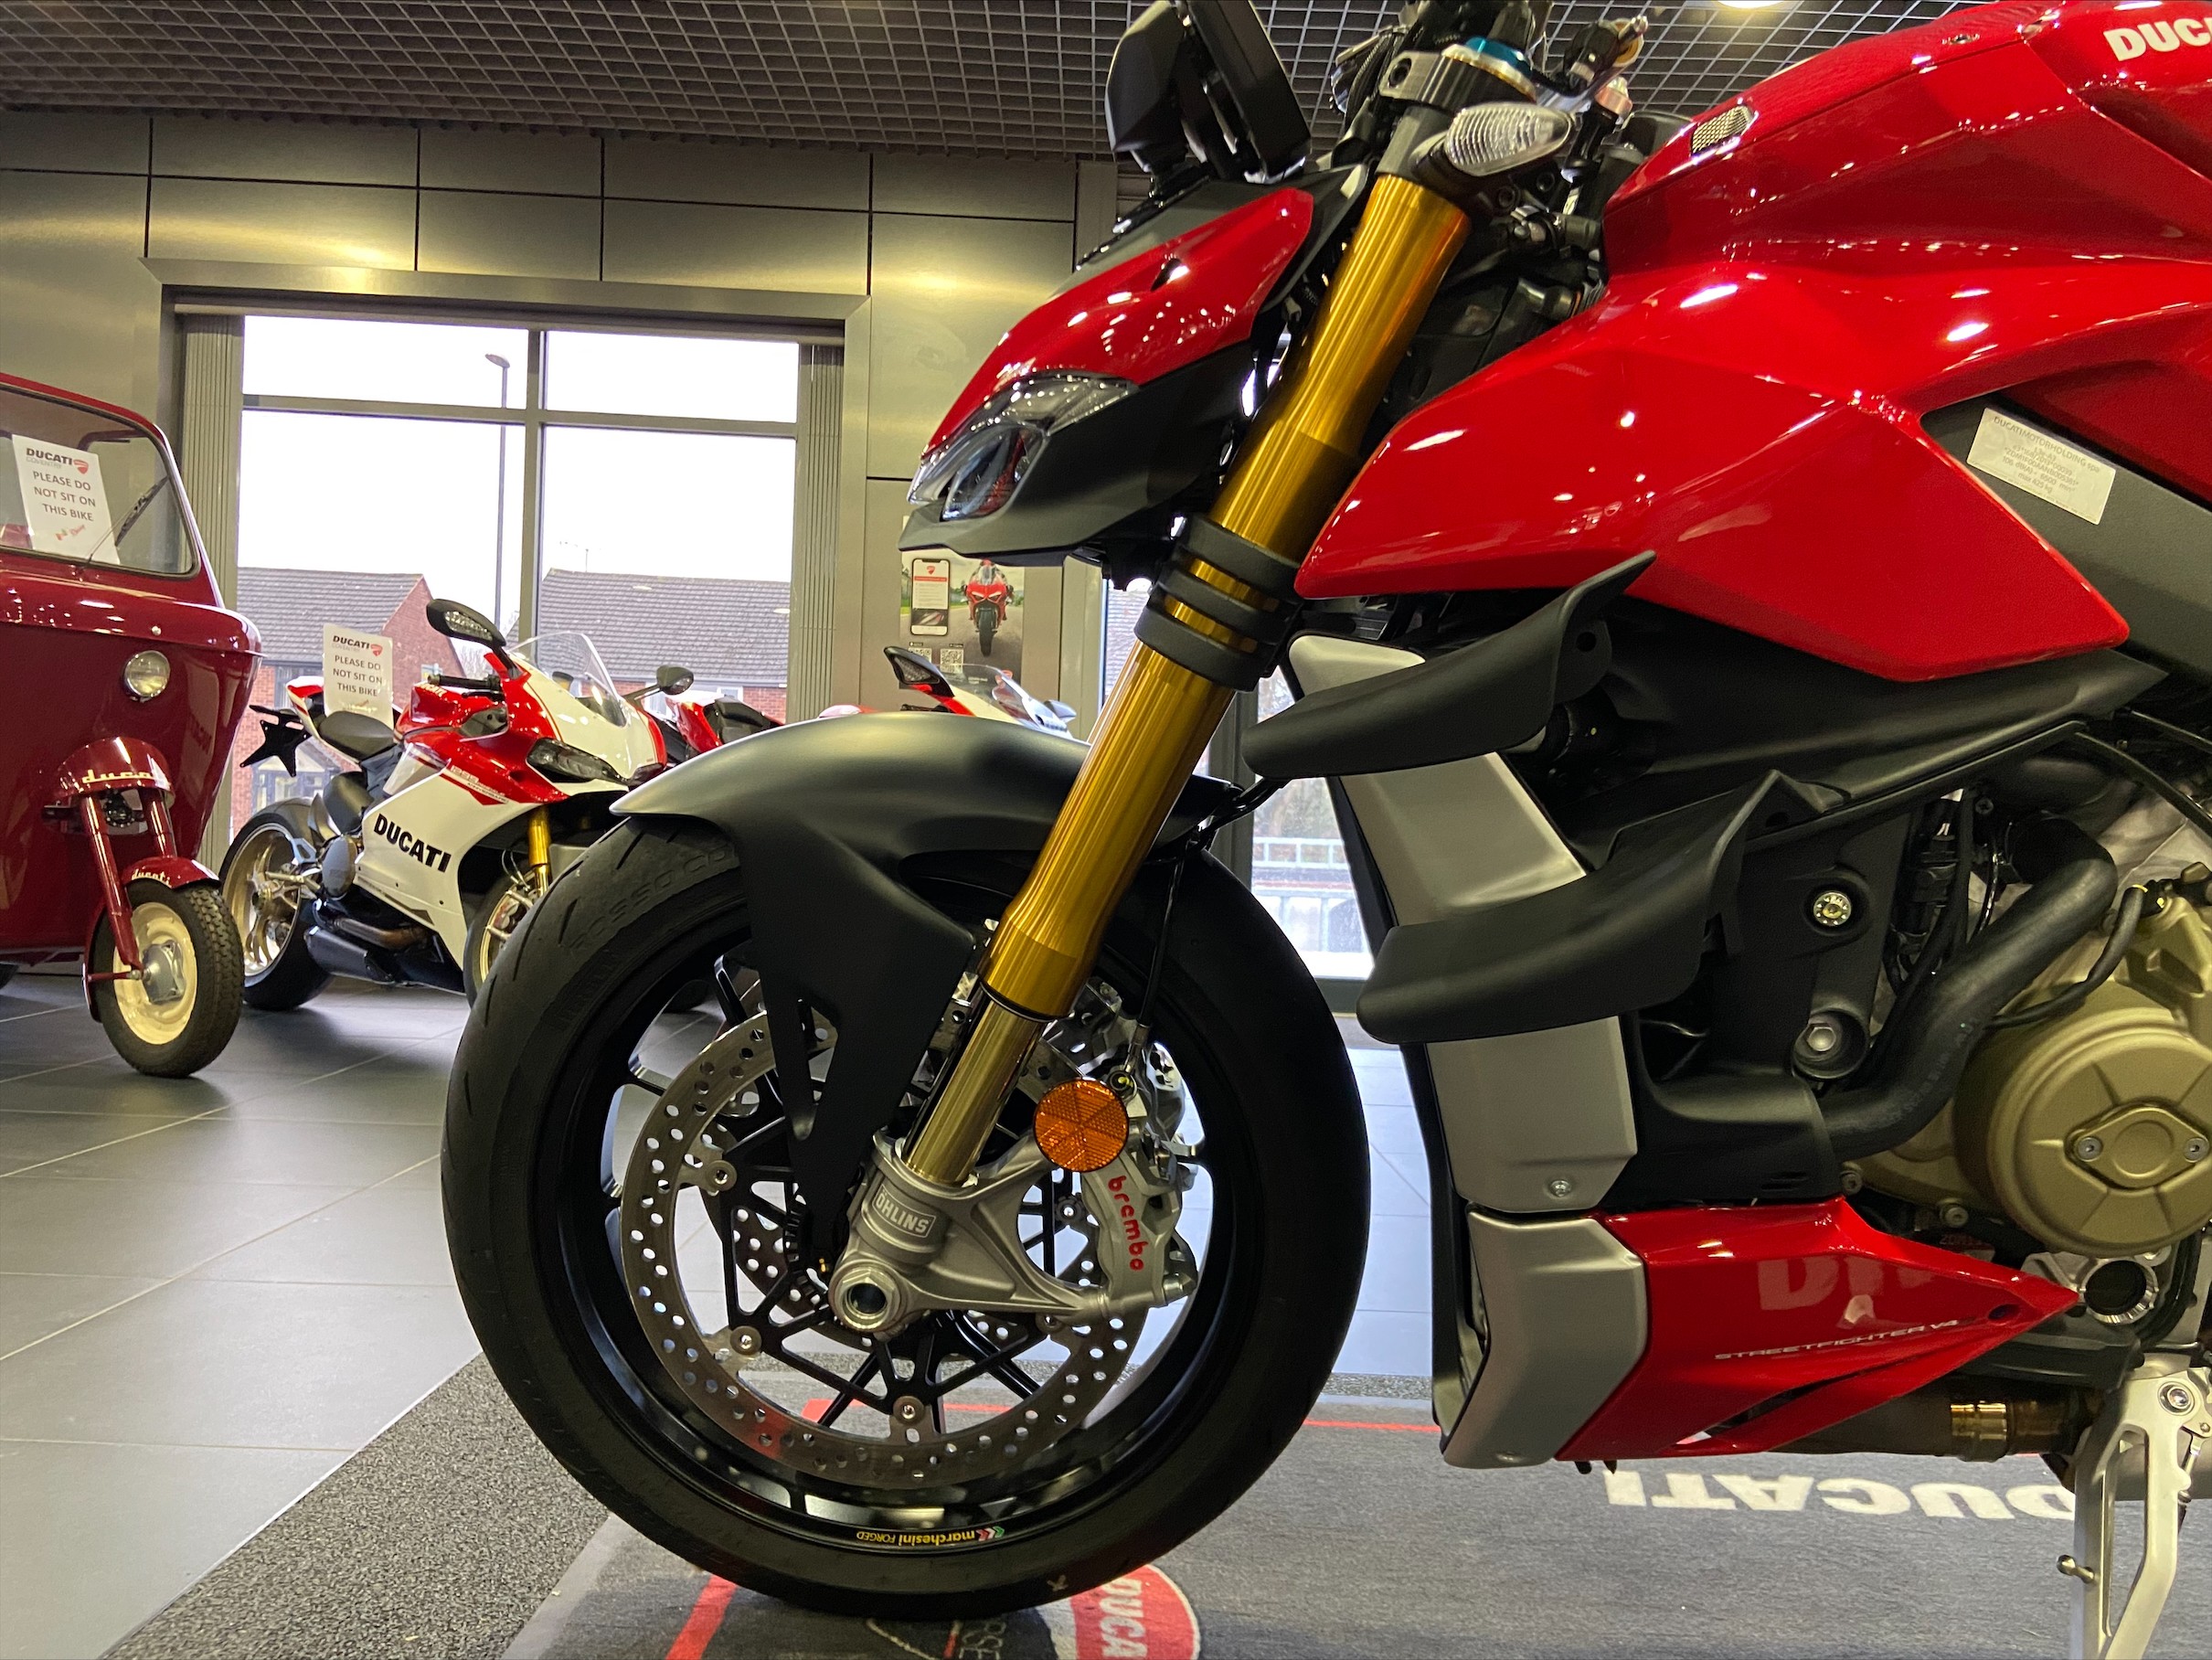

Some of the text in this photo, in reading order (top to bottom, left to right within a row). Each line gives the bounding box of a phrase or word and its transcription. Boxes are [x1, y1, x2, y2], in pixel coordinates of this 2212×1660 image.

[2103, 17, 2212, 61] DUC
[27, 448, 72, 465] DUCATI
[33, 471, 91, 491] PLEASE DO
[34, 486, 96, 507] NOT SIT ON
[42, 504, 93, 522] THIS BIKE
[333, 635, 370, 649] DUCATI
[335, 654, 381, 671] PLEASE DO
[333, 668, 382, 685] NOT SIT ON
[337, 682, 378, 697] THIS BIKE
[374, 813, 452, 873] DUCATI
[876, 1189, 930, 1233] ÖHLINS
[1108, 1176, 1148, 1271] brembo
[1714, 1319, 1958, 1359] STREETFIGHTER V4
[1603, 1469, 2075, 1520] DUCATI
[856, 1529, 975, 1546] marchesini FORGED
